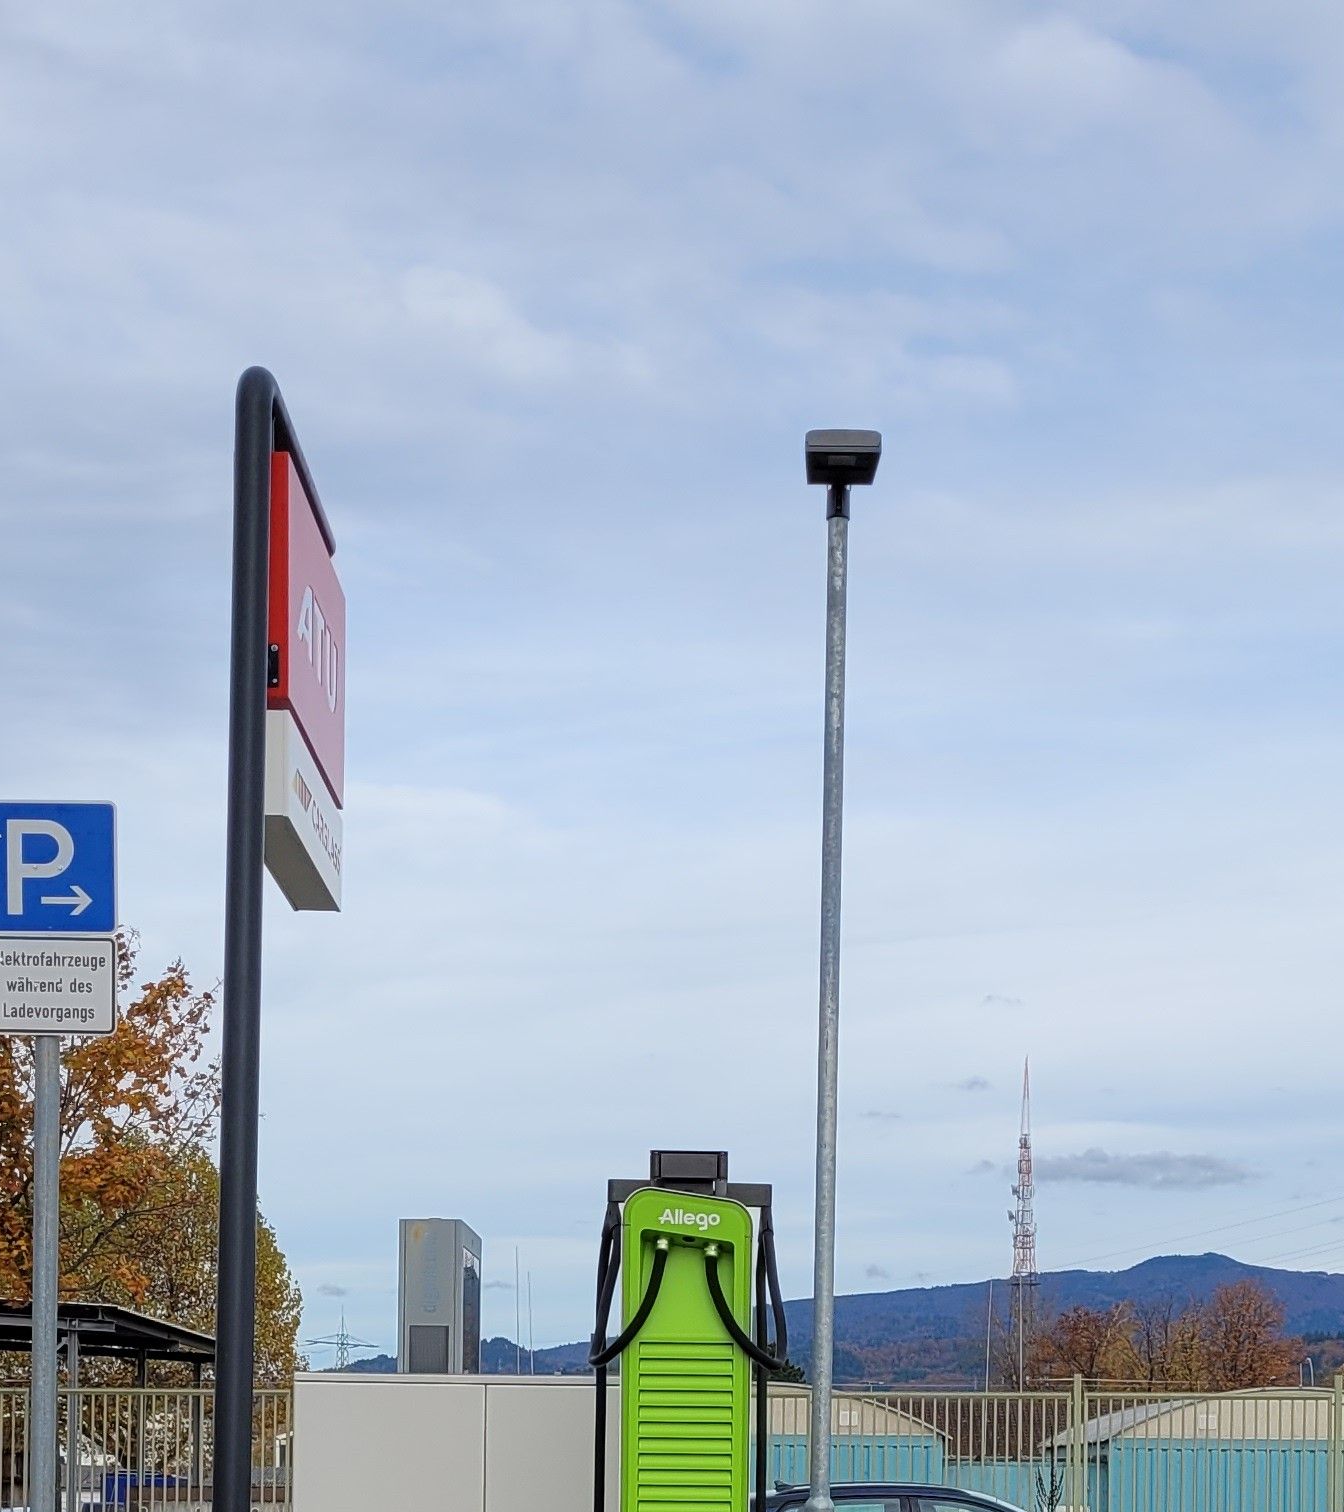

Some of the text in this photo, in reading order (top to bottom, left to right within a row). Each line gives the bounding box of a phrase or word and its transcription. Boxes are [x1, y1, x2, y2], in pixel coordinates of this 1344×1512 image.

[297, 585, 339, 714] ATU
[6, 818, 75, 916] P
[6, 977, 93, 994] während des
[3, 1003, 95, 1022] Ladevorgangs
[658, 1208, 720, 1231] Allego
